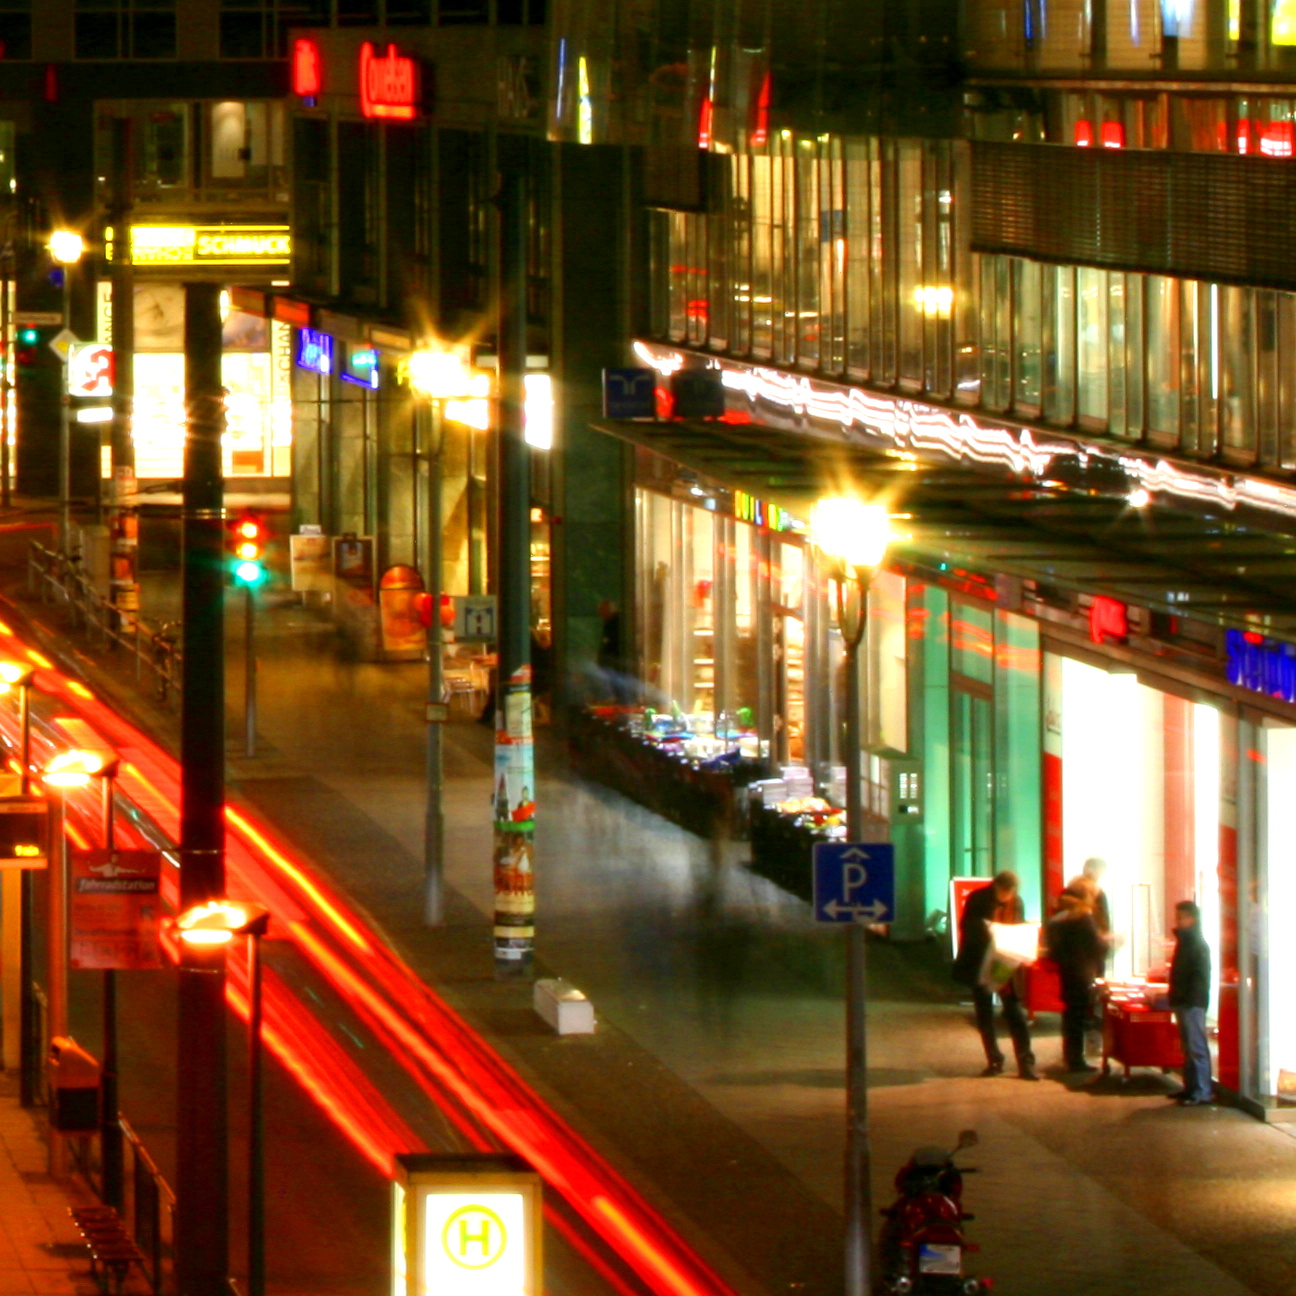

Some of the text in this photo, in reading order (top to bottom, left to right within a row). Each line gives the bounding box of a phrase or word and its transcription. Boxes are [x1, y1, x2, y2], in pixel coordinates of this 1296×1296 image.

[197, 235, 292, 256] SCHMUCK
[843, 863, 867, 903] P
[460, 1220, 489, 1255] H
